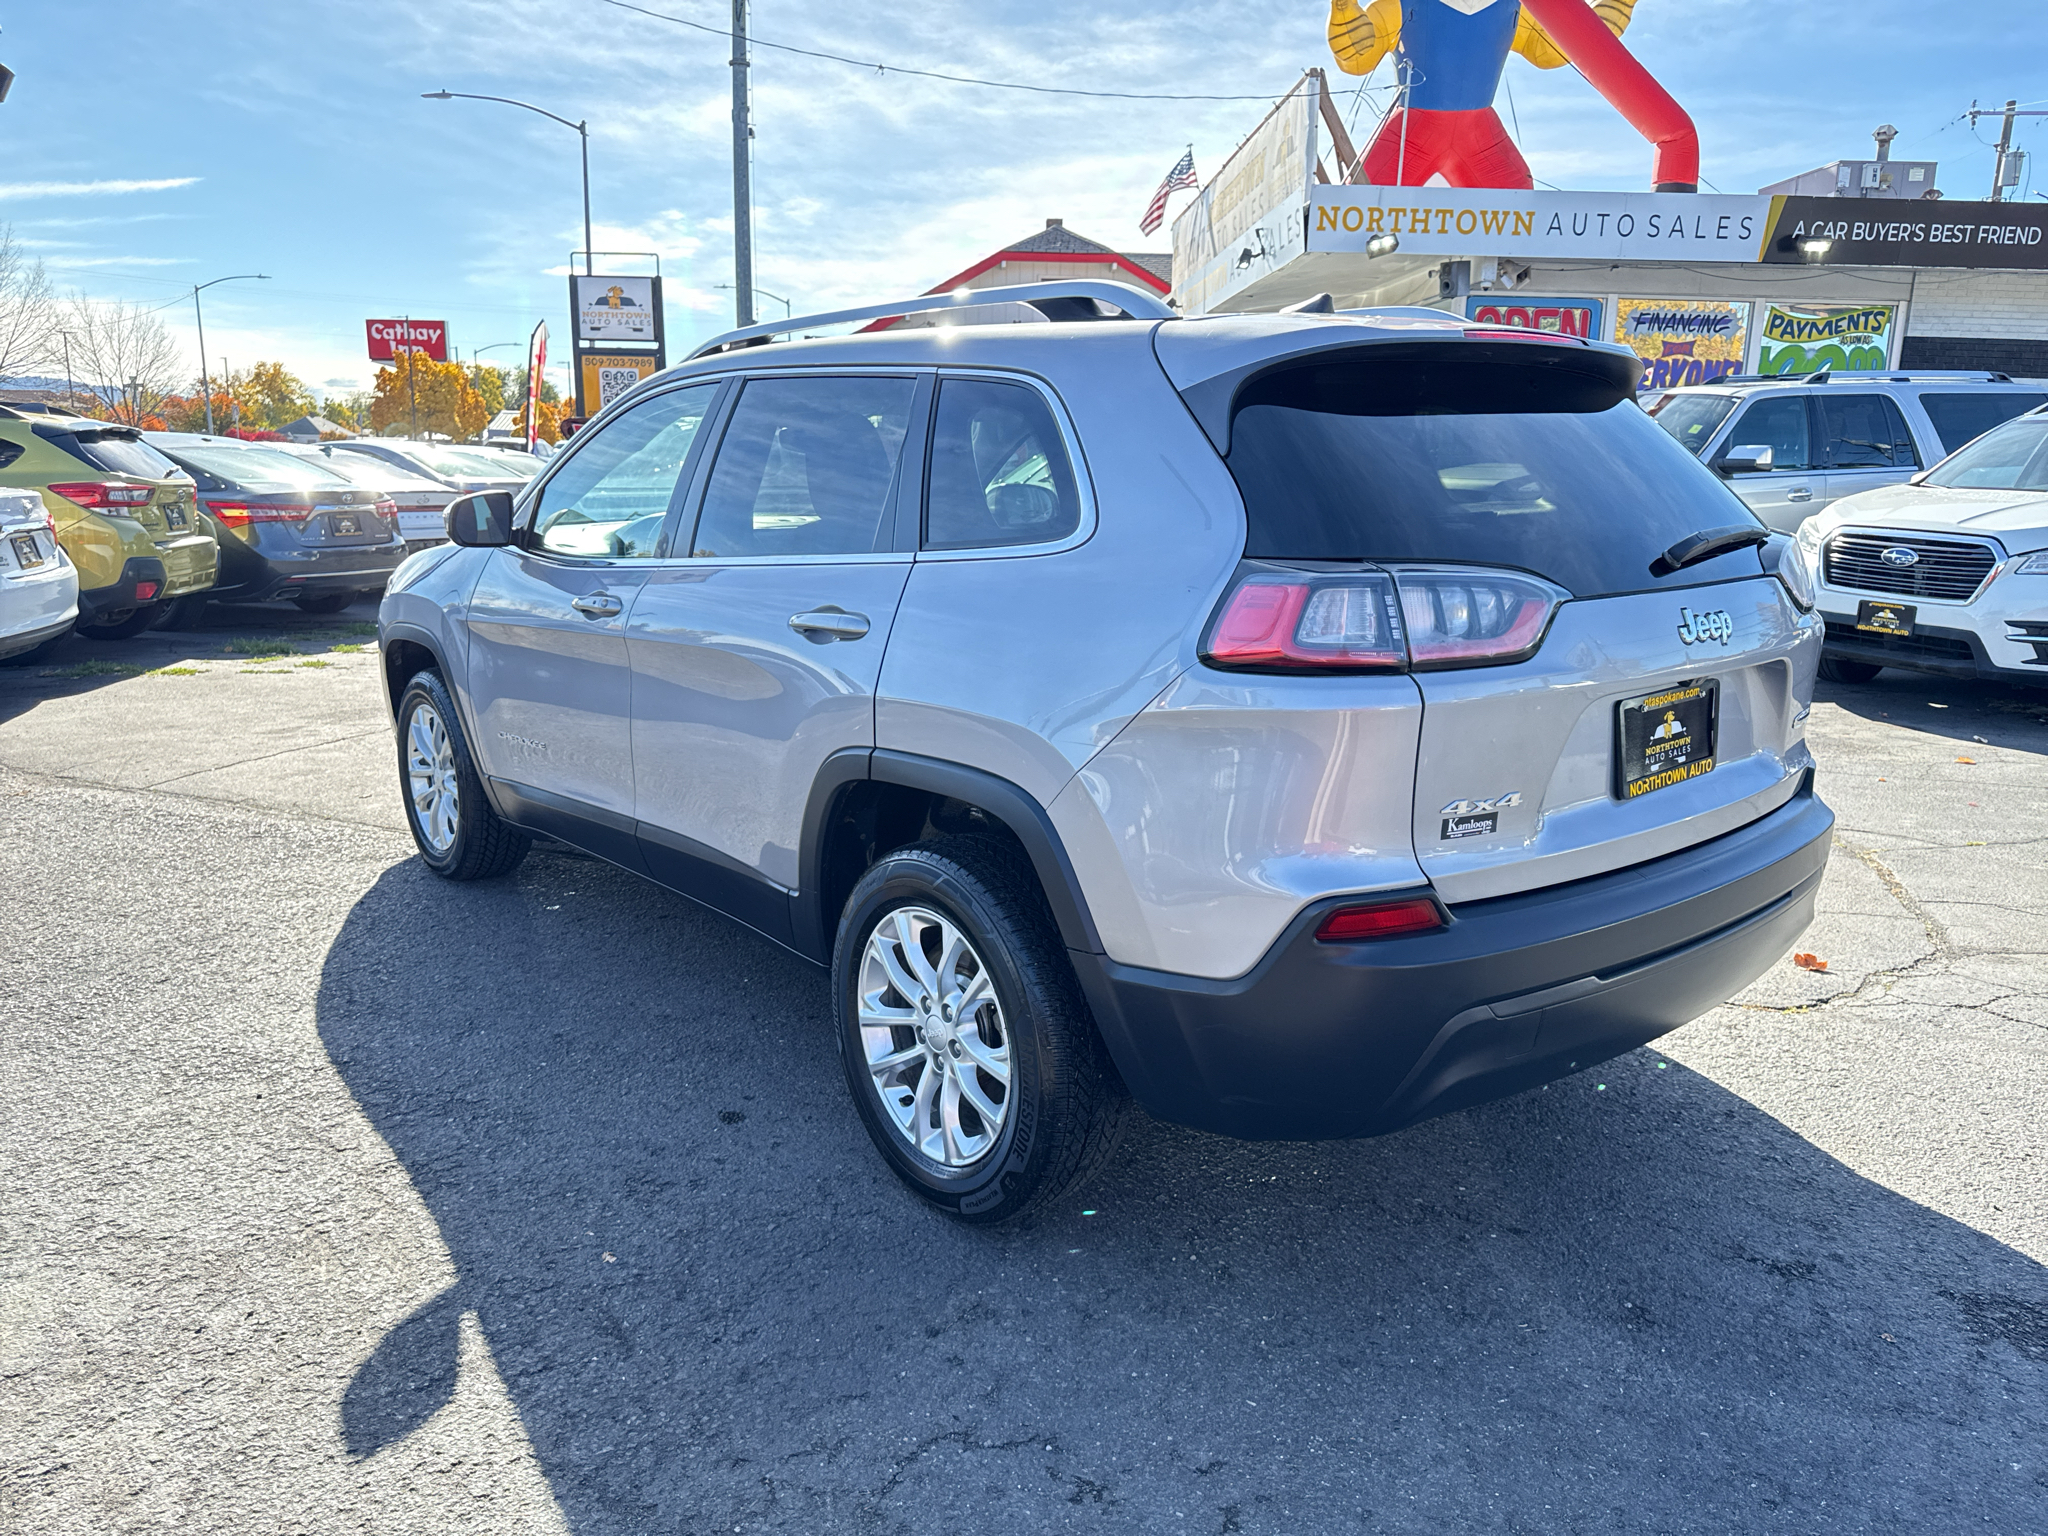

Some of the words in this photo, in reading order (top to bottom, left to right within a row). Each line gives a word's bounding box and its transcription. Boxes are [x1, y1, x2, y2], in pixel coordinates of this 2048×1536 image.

[1316, 205, 1536, 237] NORTHTOWN
[1546, 212, 1635, 238] AUTO
[1646, 213, 1754, 241] SALES
[1792, 220, 1806, 239] A
[1811, 221, 1848, 240] CAR
[1851, 222, 1926, 242] BUYER'S
[1929, 224, 1975, 244] BEST
[1977, 225, 2042, 246] FRIEND
[581, 311, 651, 320] NORTHTOWN
[581, 318, 612, 326] AUTO
[617, 319, 652, 327] SALES
[1634, 312, 1731, 334] FINANCING
[1768, 310, 1886, 340] PAYMENTS
[371, 322, 442, 344] Cathay
[1664, 344, 1691, 355] FOR
[584, 357, 653, 368] 509-703-7989
[1677, 607, 1733, 646] Jeep
[1645, 736, 1692, 756] NORTHTOWN
[1645, 752, 1666, 765] AUTO
[1668, 744, 1691, 758] SALES
[1629, 766, 1688, 798] NORTHTOWN
[1689, 758, 1713, 776] AUTO
[1440, 791, 1523, 815] 4x4
[1448, 817, 1493, 832] Kamloops
[1012, 1035, 1035, 1164] BRIDGESTONE
